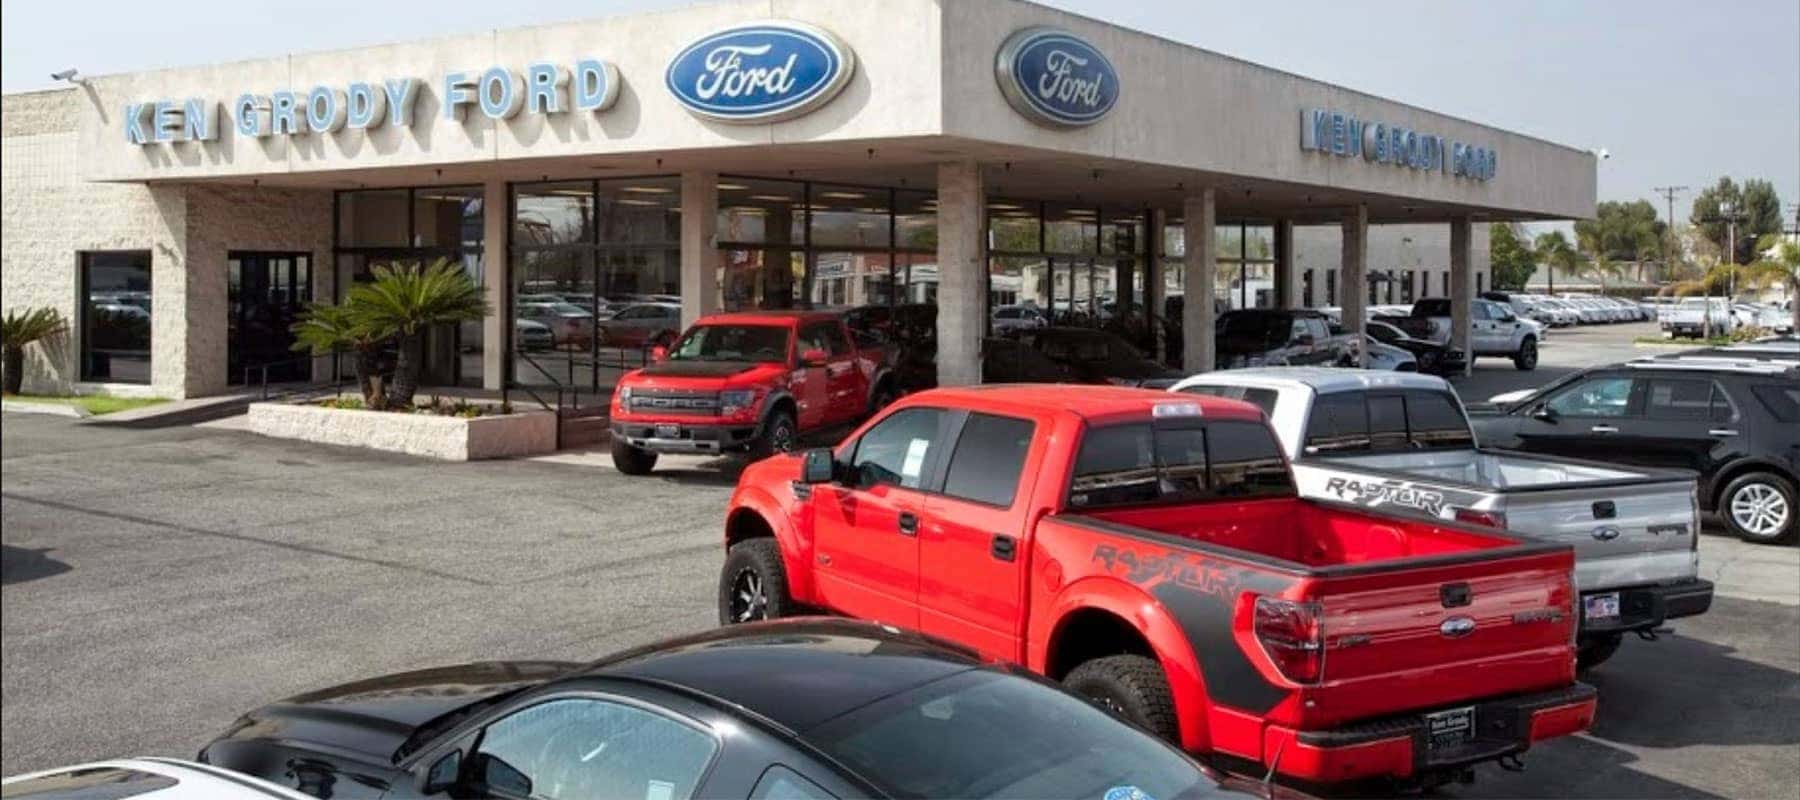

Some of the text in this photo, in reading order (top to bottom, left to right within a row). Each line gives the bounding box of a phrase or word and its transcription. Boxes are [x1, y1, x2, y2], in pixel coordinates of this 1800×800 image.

[696, 44, 797, 98] Ford
[1039, 50, 1103, 107] Ford
[124, 59, 610, 144] KEN GRODY FORD
[1313, 109, 1360, 157] KEN
[1326, 477, 1443, 518] RAPTOR
[1092, 544, 1240, 602] RAPTOR
